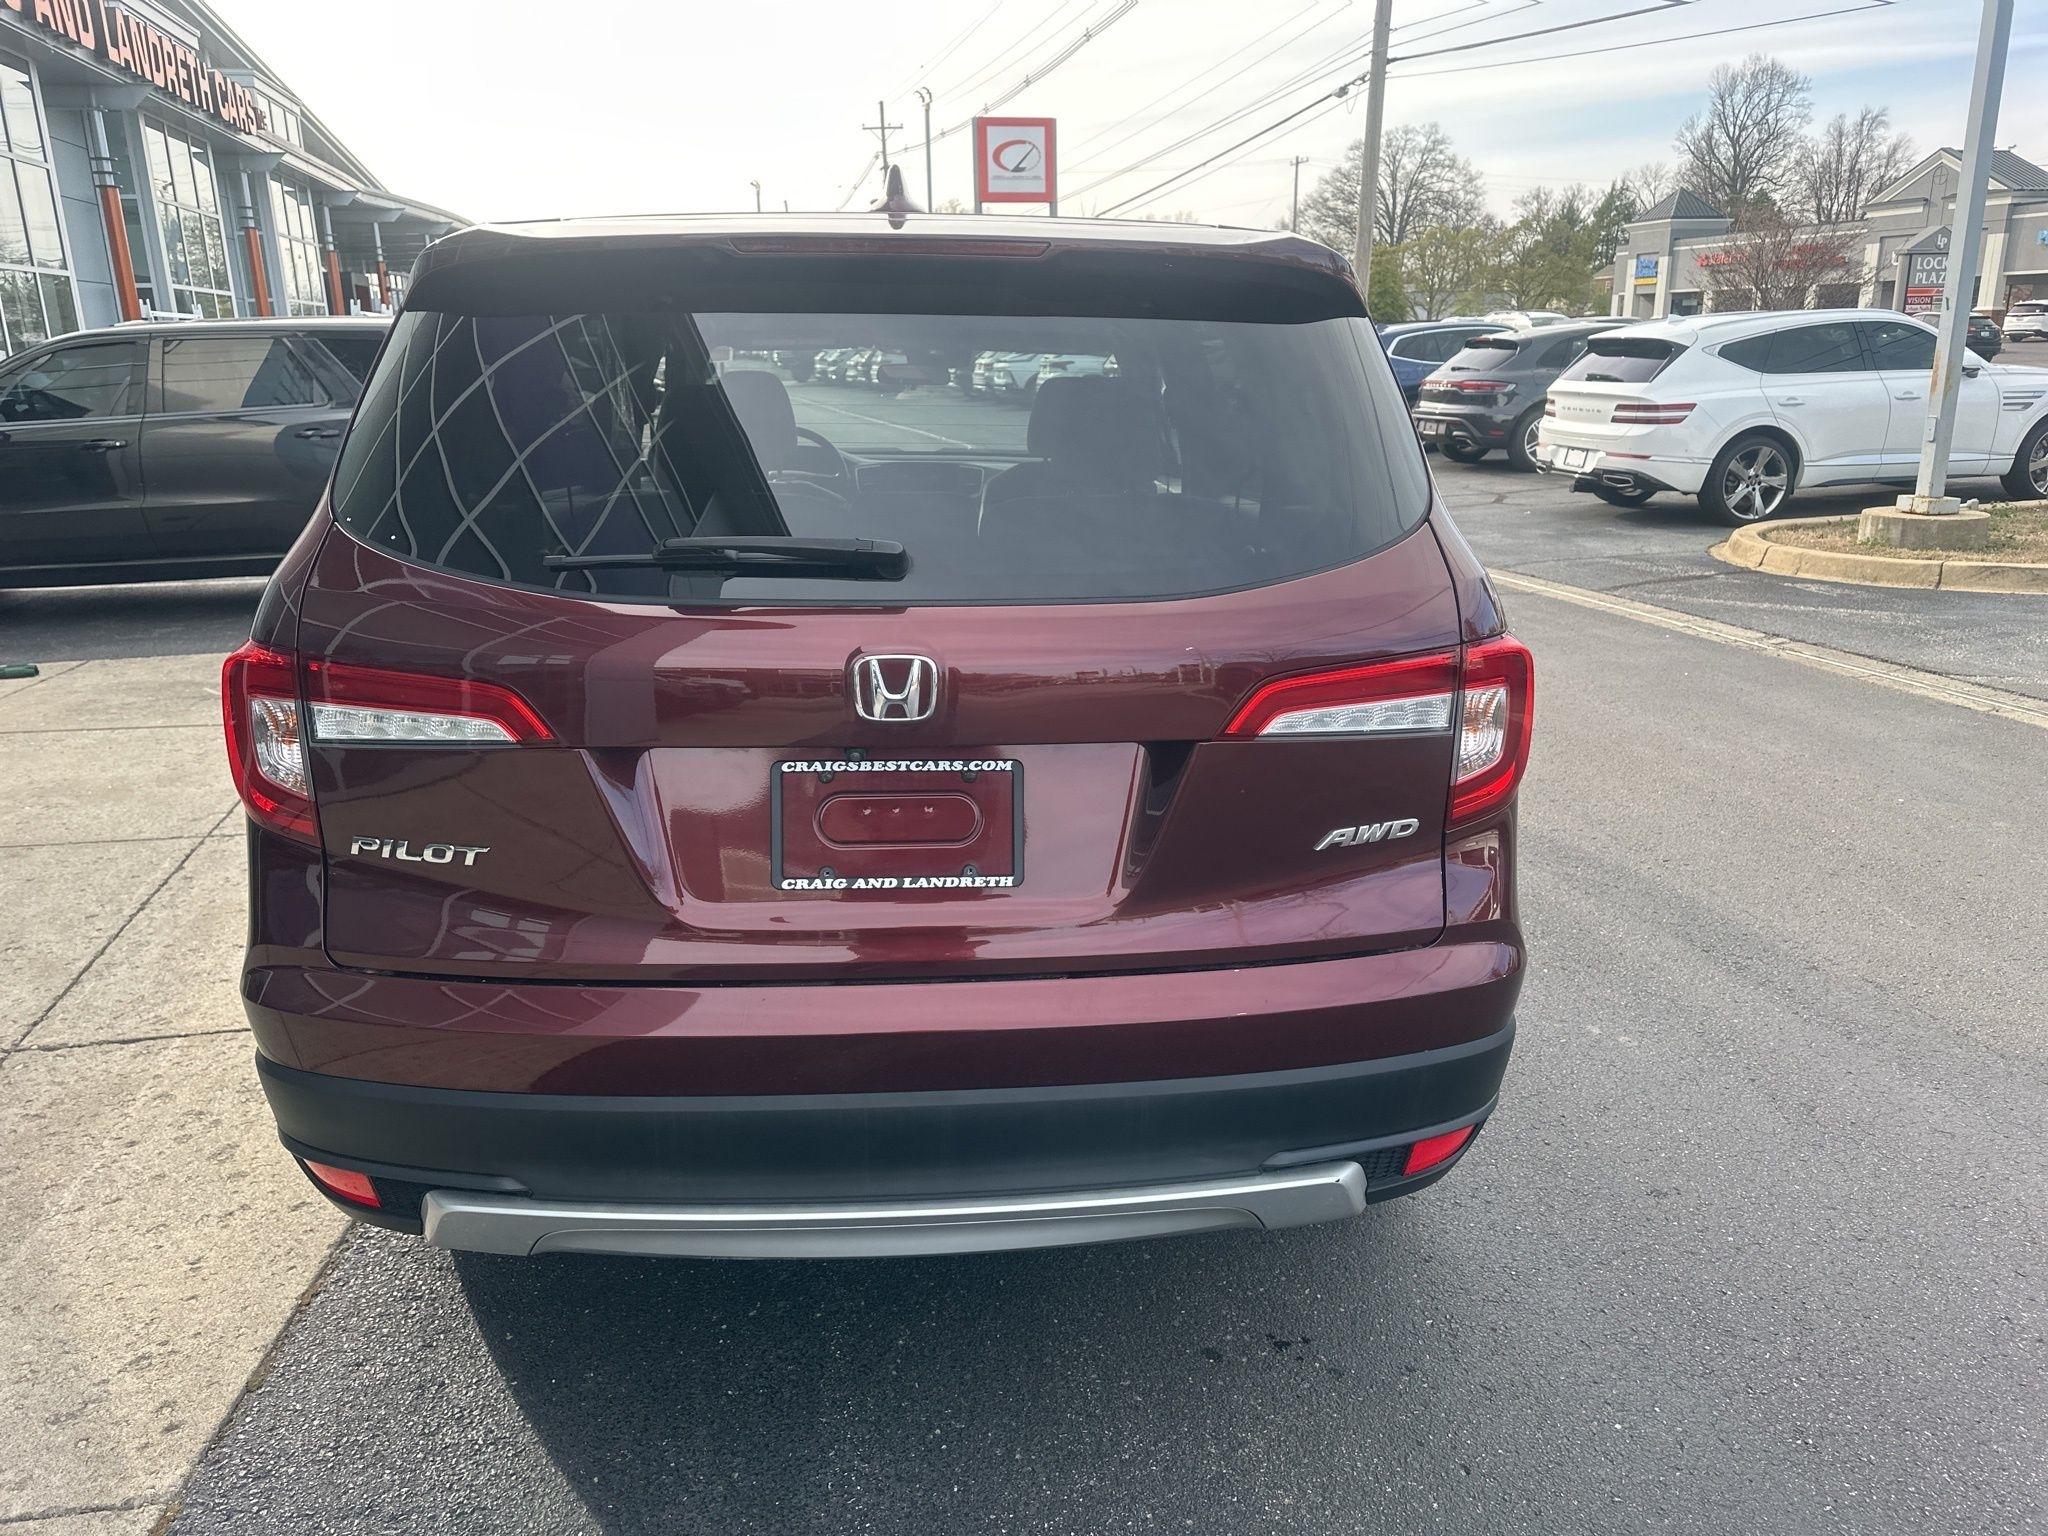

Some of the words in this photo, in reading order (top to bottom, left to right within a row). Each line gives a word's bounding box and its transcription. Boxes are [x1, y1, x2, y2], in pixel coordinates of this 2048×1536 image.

[100, 0, 214, 113] LANDRETH
[214, 69, 257, 135] CARS
[1915, 271, 1946, 285] PLAZ
[1907, 296, 1931, 304] VISION
[781, 760, 1013, 772] CRAIGSBESTCARS.COM
[1313, 818, 1420, 851] AWD
[350, 836, 490, 866] PILOT
[781, 878, 847, 890] CRAIG
[852, 877, 898, 889] AND
[904, 876, 1014, 888] LANDRETH
